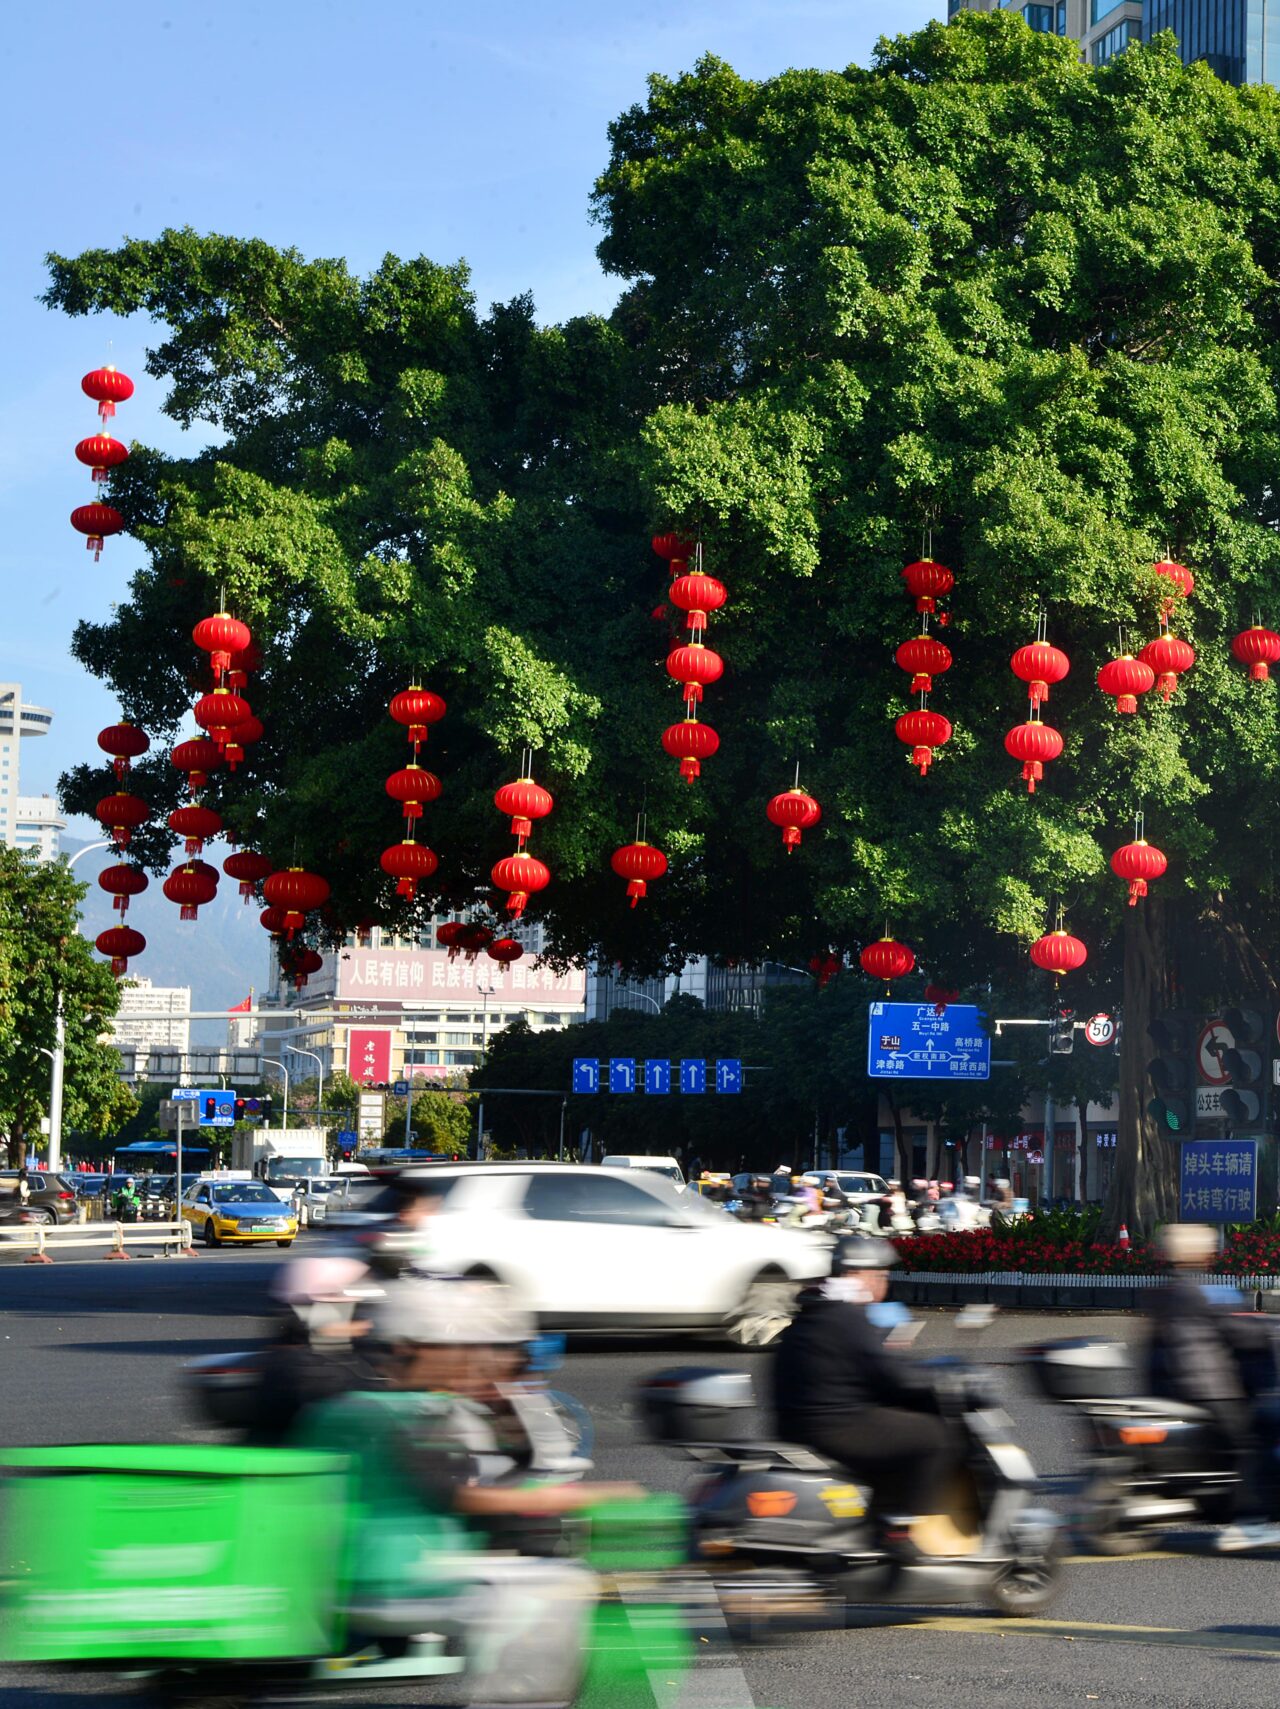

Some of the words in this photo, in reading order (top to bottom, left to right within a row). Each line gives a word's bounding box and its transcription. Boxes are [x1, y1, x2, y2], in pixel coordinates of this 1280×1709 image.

[350, 959, 424, 986] 人民有信仰
[432, 961, 505, 989] 民族有希望
[512, 964, 584, 991] 国家有力量
[912, 1021, 949, 1031] 五一中路
[1092, 1023, 1110, 1037] 50
[881, 1035, 900, 1046] 于山
[955, 1037, 983, 1048] 高桥路
[876, 1059, 904, 1070] 津泰路
[950, 1061, 987, 1072] 国货西路
[1197, 1092, 1224, 1111] 公交车
[1184, 1152, 1253, 1177] 掉头车辆请
[1183, 1187, 1251, 1211] 大转弯行驶
